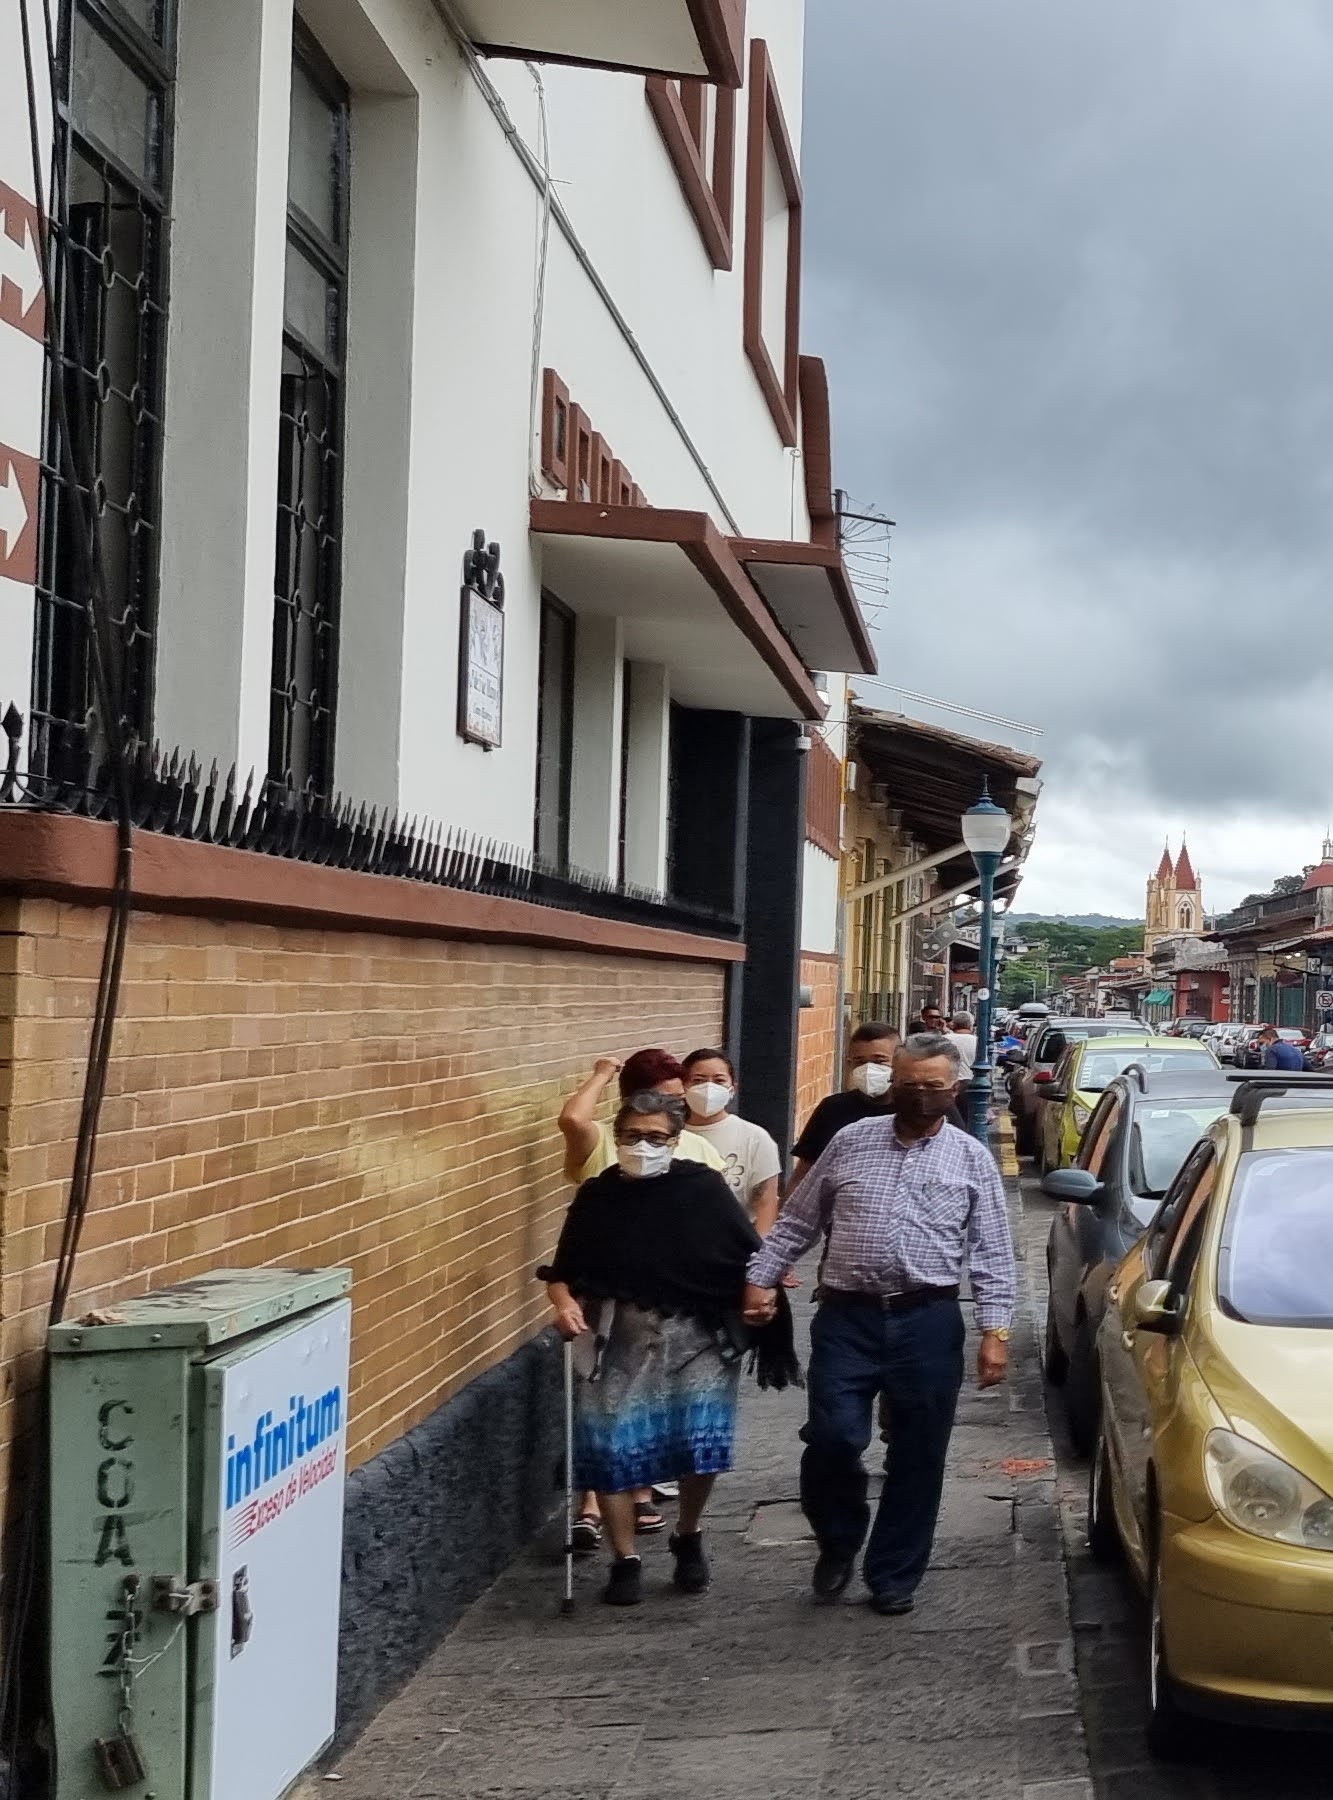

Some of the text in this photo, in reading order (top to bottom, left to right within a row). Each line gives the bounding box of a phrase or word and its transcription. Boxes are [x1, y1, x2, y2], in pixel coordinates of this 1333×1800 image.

[227, 1385, 341, 1511] infinitum
[242, 1440, 339, 1542] Exceso de Velocidad
